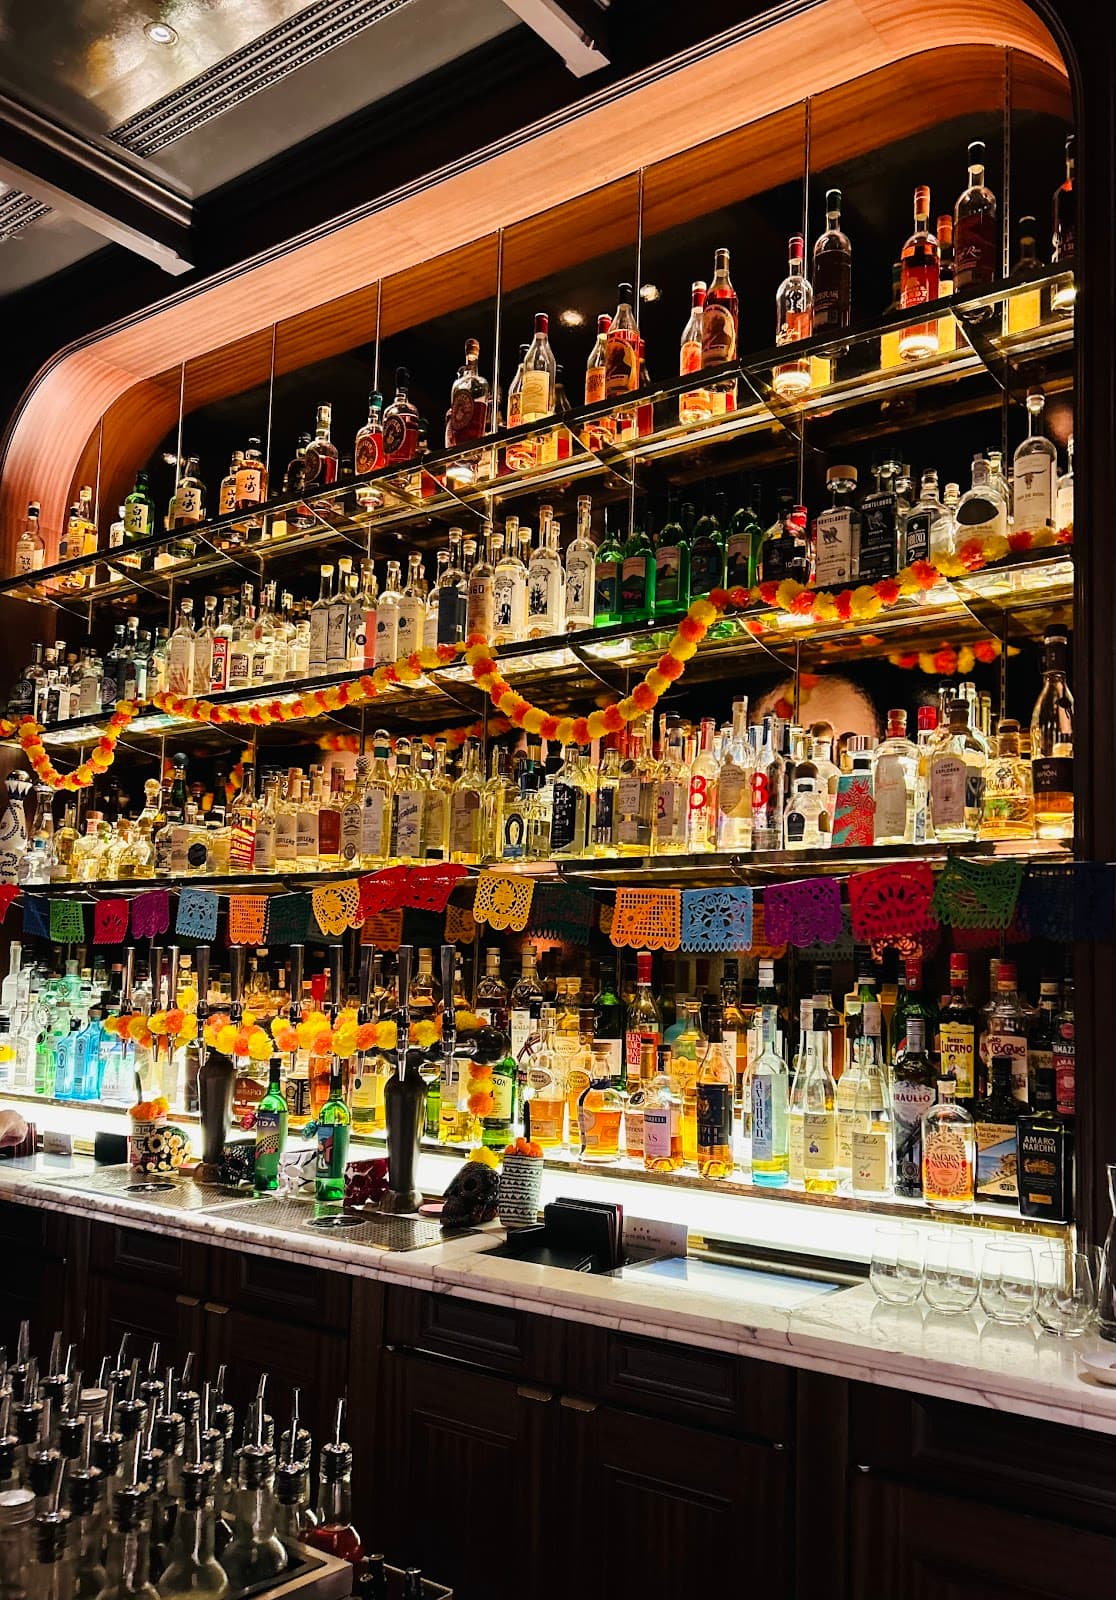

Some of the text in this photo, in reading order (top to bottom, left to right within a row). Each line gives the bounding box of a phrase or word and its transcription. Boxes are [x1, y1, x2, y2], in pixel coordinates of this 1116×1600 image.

[130, 505, 142, 529] 白州
[1023, 1135, 1056, 1146] AMARO
[1022, 1142, 1057, 1153] NARDINI
[932, 1152, 960, 1162] AMARO
